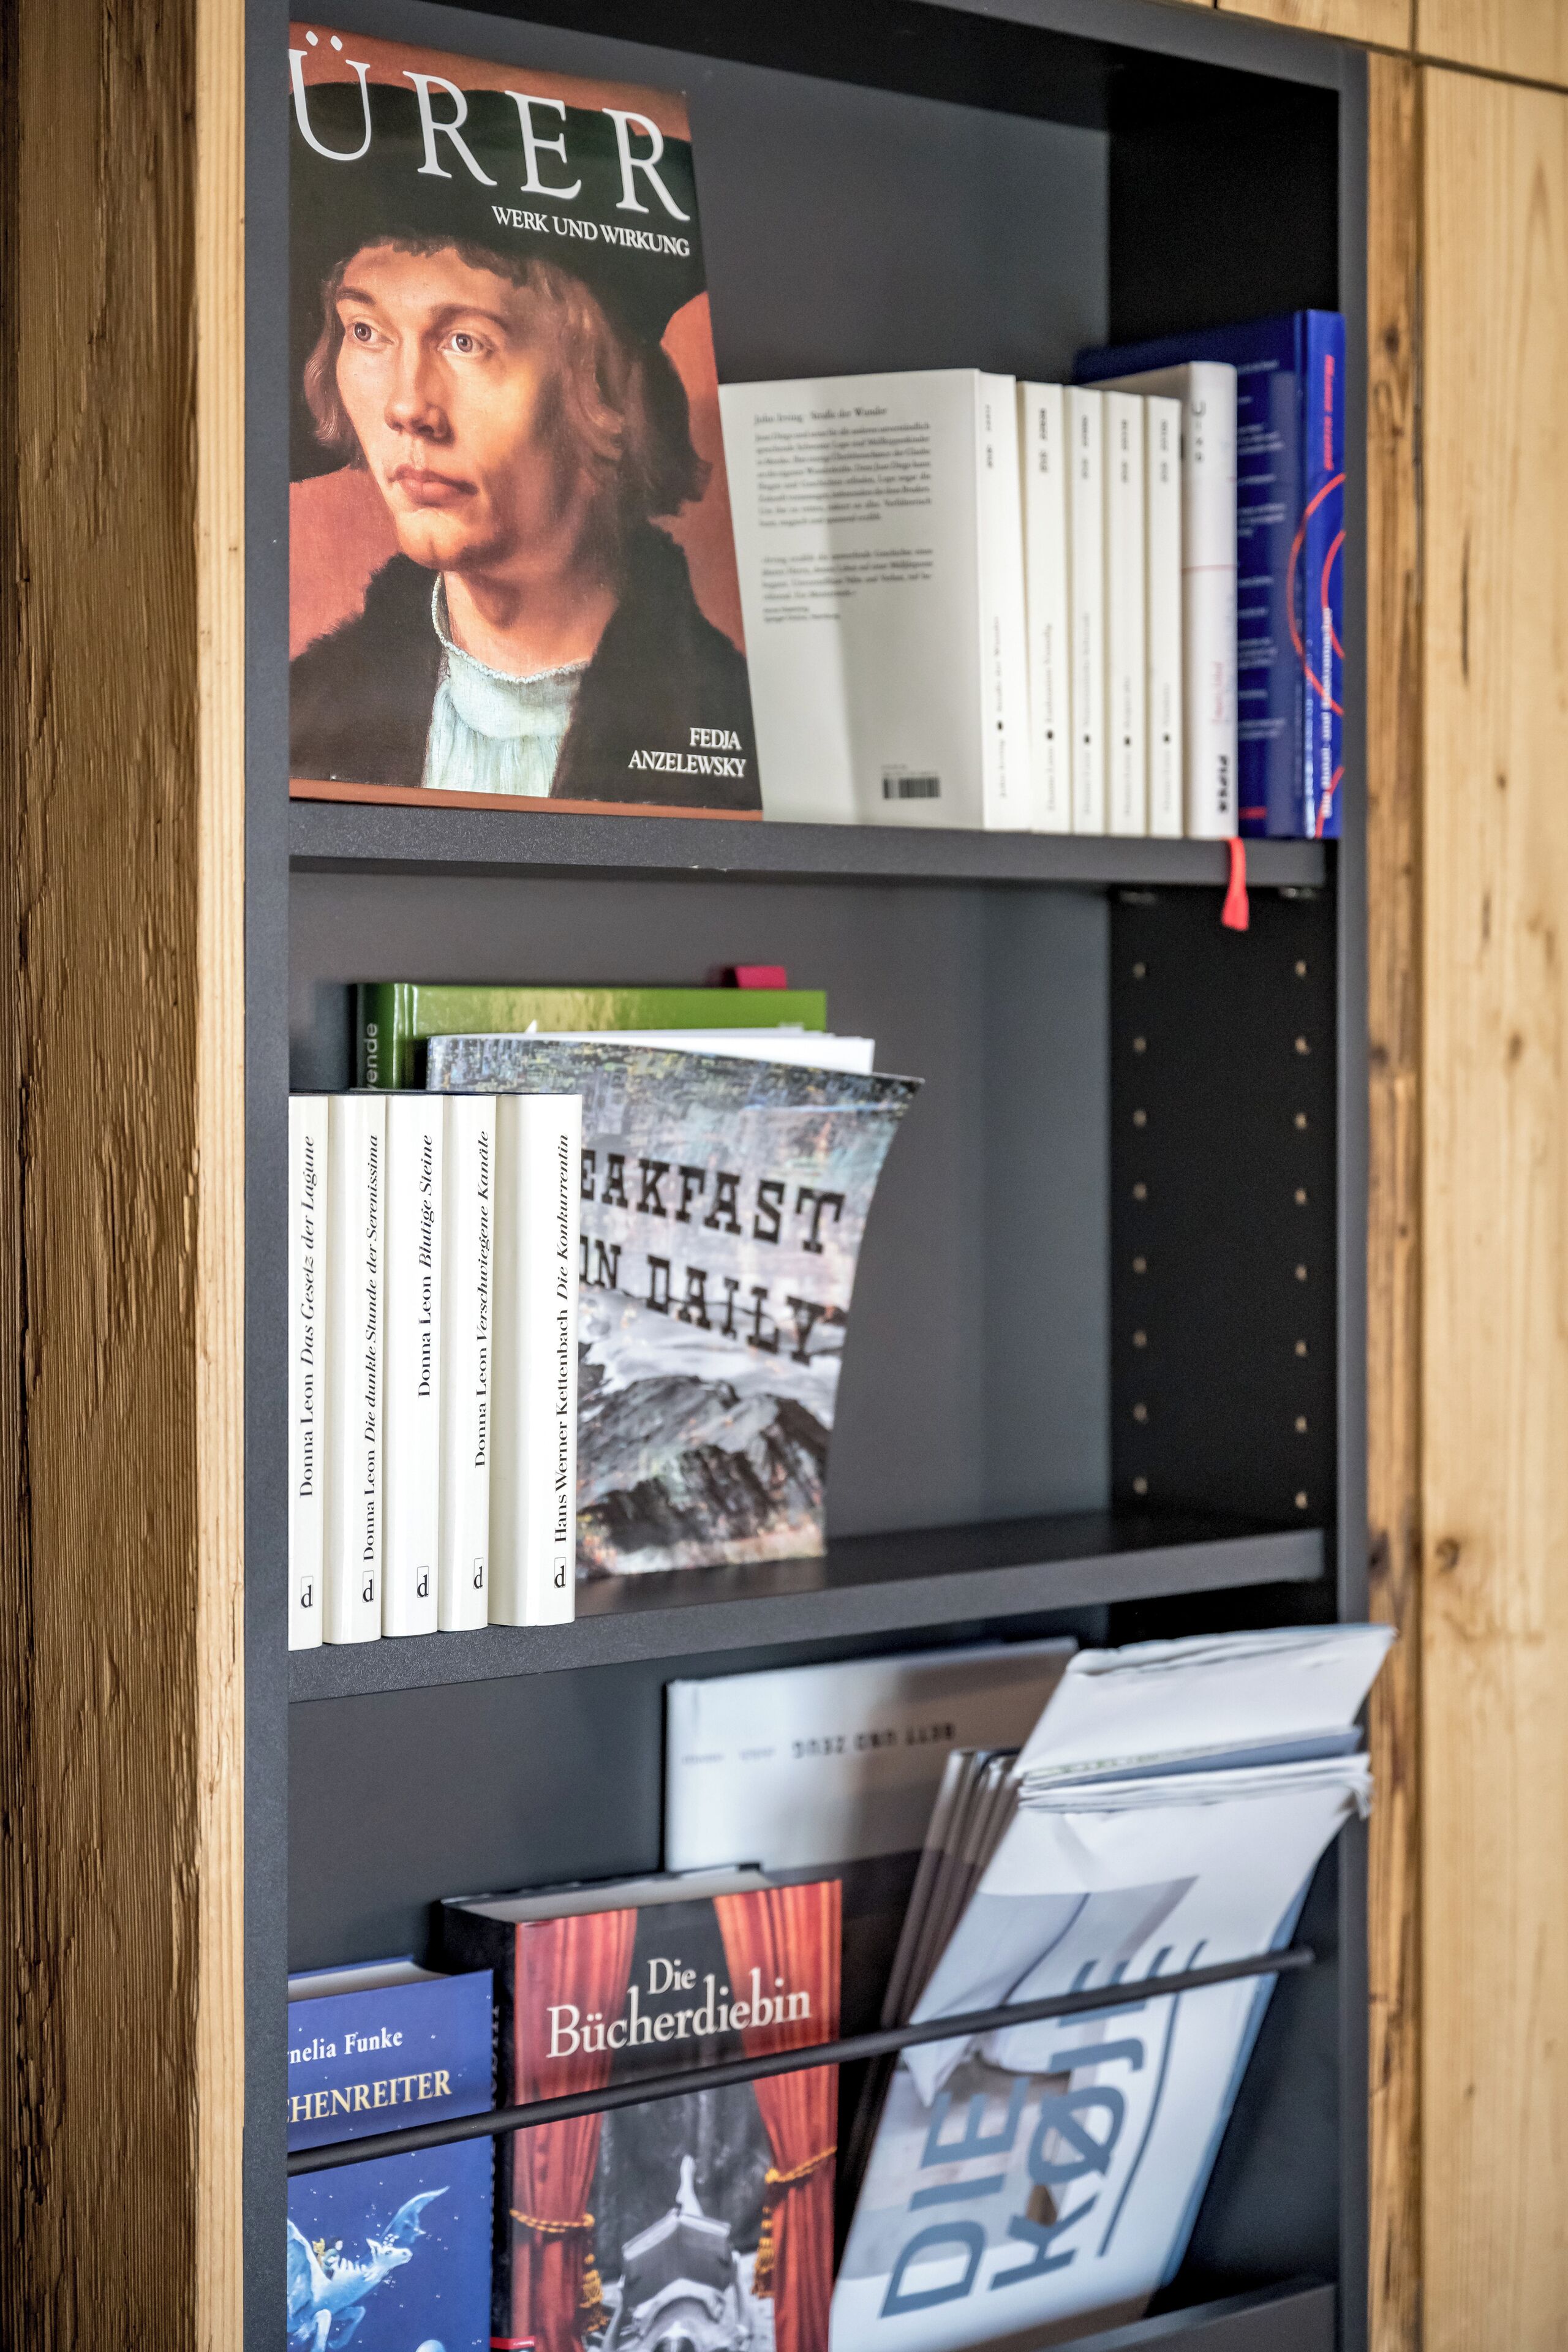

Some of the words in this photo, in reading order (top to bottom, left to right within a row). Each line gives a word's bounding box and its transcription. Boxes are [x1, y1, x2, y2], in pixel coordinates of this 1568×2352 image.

[289, 31, 690, 221] ÜRER
[492, 205, 550, 233] WERK
[552, 216, 598, 241] UND
[600, 224, 690, 257] WIRKUNG
[628, 749, 747, 778] ANZELEWSKY
[689, 727, 742, 751] FEDJA
[301, 1136, 317, 1211] Lagune
[366, 1135, 378, 1240] Serenissima
[420, 1134, 432, 1196] Steine
[477, 1131, 489, 1200] Kanäle
[557, 1134, 568, 1261] Konkurrentin
[301, 1216, 314, 1250] der
[366, 1243, 377, 1274] der
[419, 1200, 434, 1269] Blutige
[301, 1256, 314, 1320] Gesetz
[419, 1276, 431, 1324] Leon
[477, 1205, 490, 1341] Verschwiegene
[557, 1266, 568, 1301] Die
[365, 1280, 377, 1343] Stunde
[646, 1254, 827, 1366] DAILY
[300, 1325, 314, 1365] Das
[418, 1332, 431, 1398] Donna
[476, 1348, 488, 1397] Leon
[556, 1310, 568, 1416] Kettenbach
[300, 1374, 314, 1425] Leon
[364, 1346, 377, 1408] dunkle
[364, 1411, 376, 1443] Die
[475, 1403, 486, 1468] Donna
[300, 1430, 314, 1498] Donna
[364, 1450, 375, 1496] Leon
[555, 1421, 568, 1493] Werner
[363, 1501, 375, 1561] Donna
[554, 1494, 567, 1543] Hans
[301, 1585, 313, 1608] d
[362, 1578, 374, 1604] d
[417, 1574, 429, 1598] d
[473, 1566, 483, 1589] d
[554, 1565, 566, 1588] d
[647, 1957, 697, 1996] Die
[546, 1967, 812, 2059] Bücherdiebin
[287, 2037, 337, 2064] nelia
[344, 2026, 404, 2055] Funke
[287, 2069, 453, 2124] HENREITER
[880, 2077, 1031, 2319] DIE
